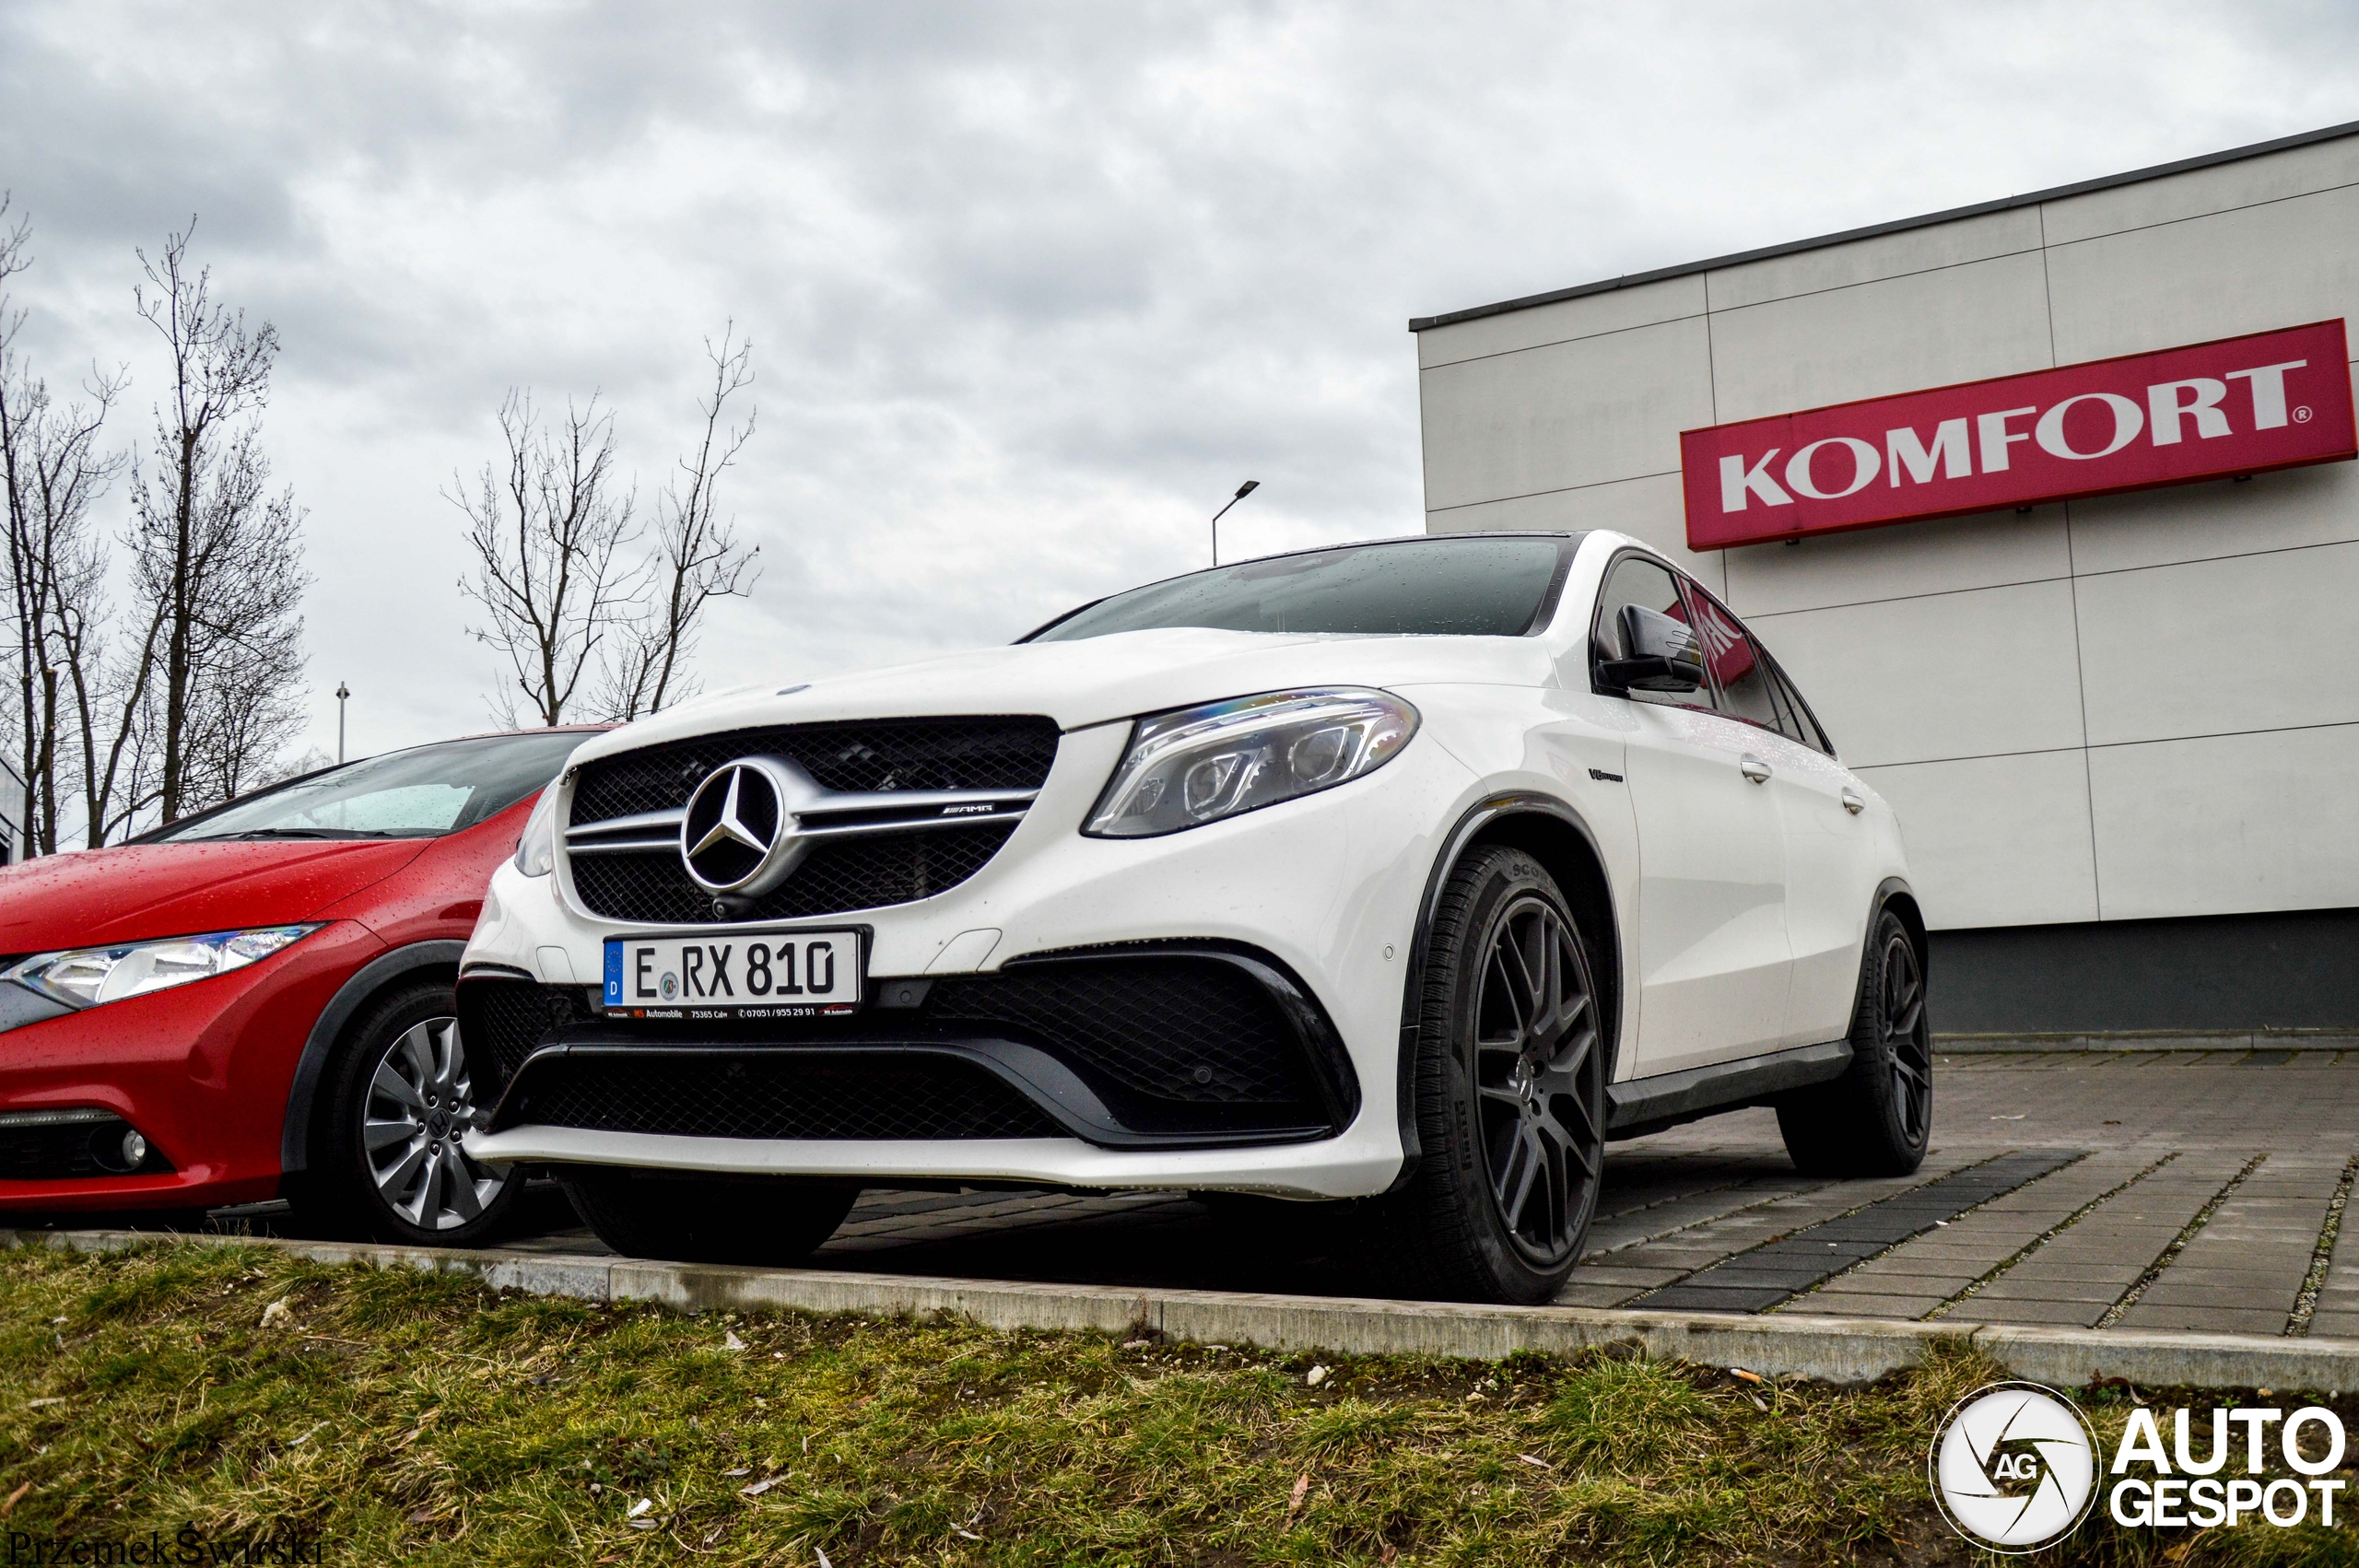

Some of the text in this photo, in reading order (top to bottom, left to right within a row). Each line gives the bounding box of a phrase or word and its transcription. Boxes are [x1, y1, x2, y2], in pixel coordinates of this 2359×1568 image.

[636, 941, 834, 998] E RX 810
[610, 980, 617, 996] D
[646, 1009, 683, 1018] Automobile
[691, 1010, 712, 1019] 75365
[746, 1009, 770, 1017] 07051
